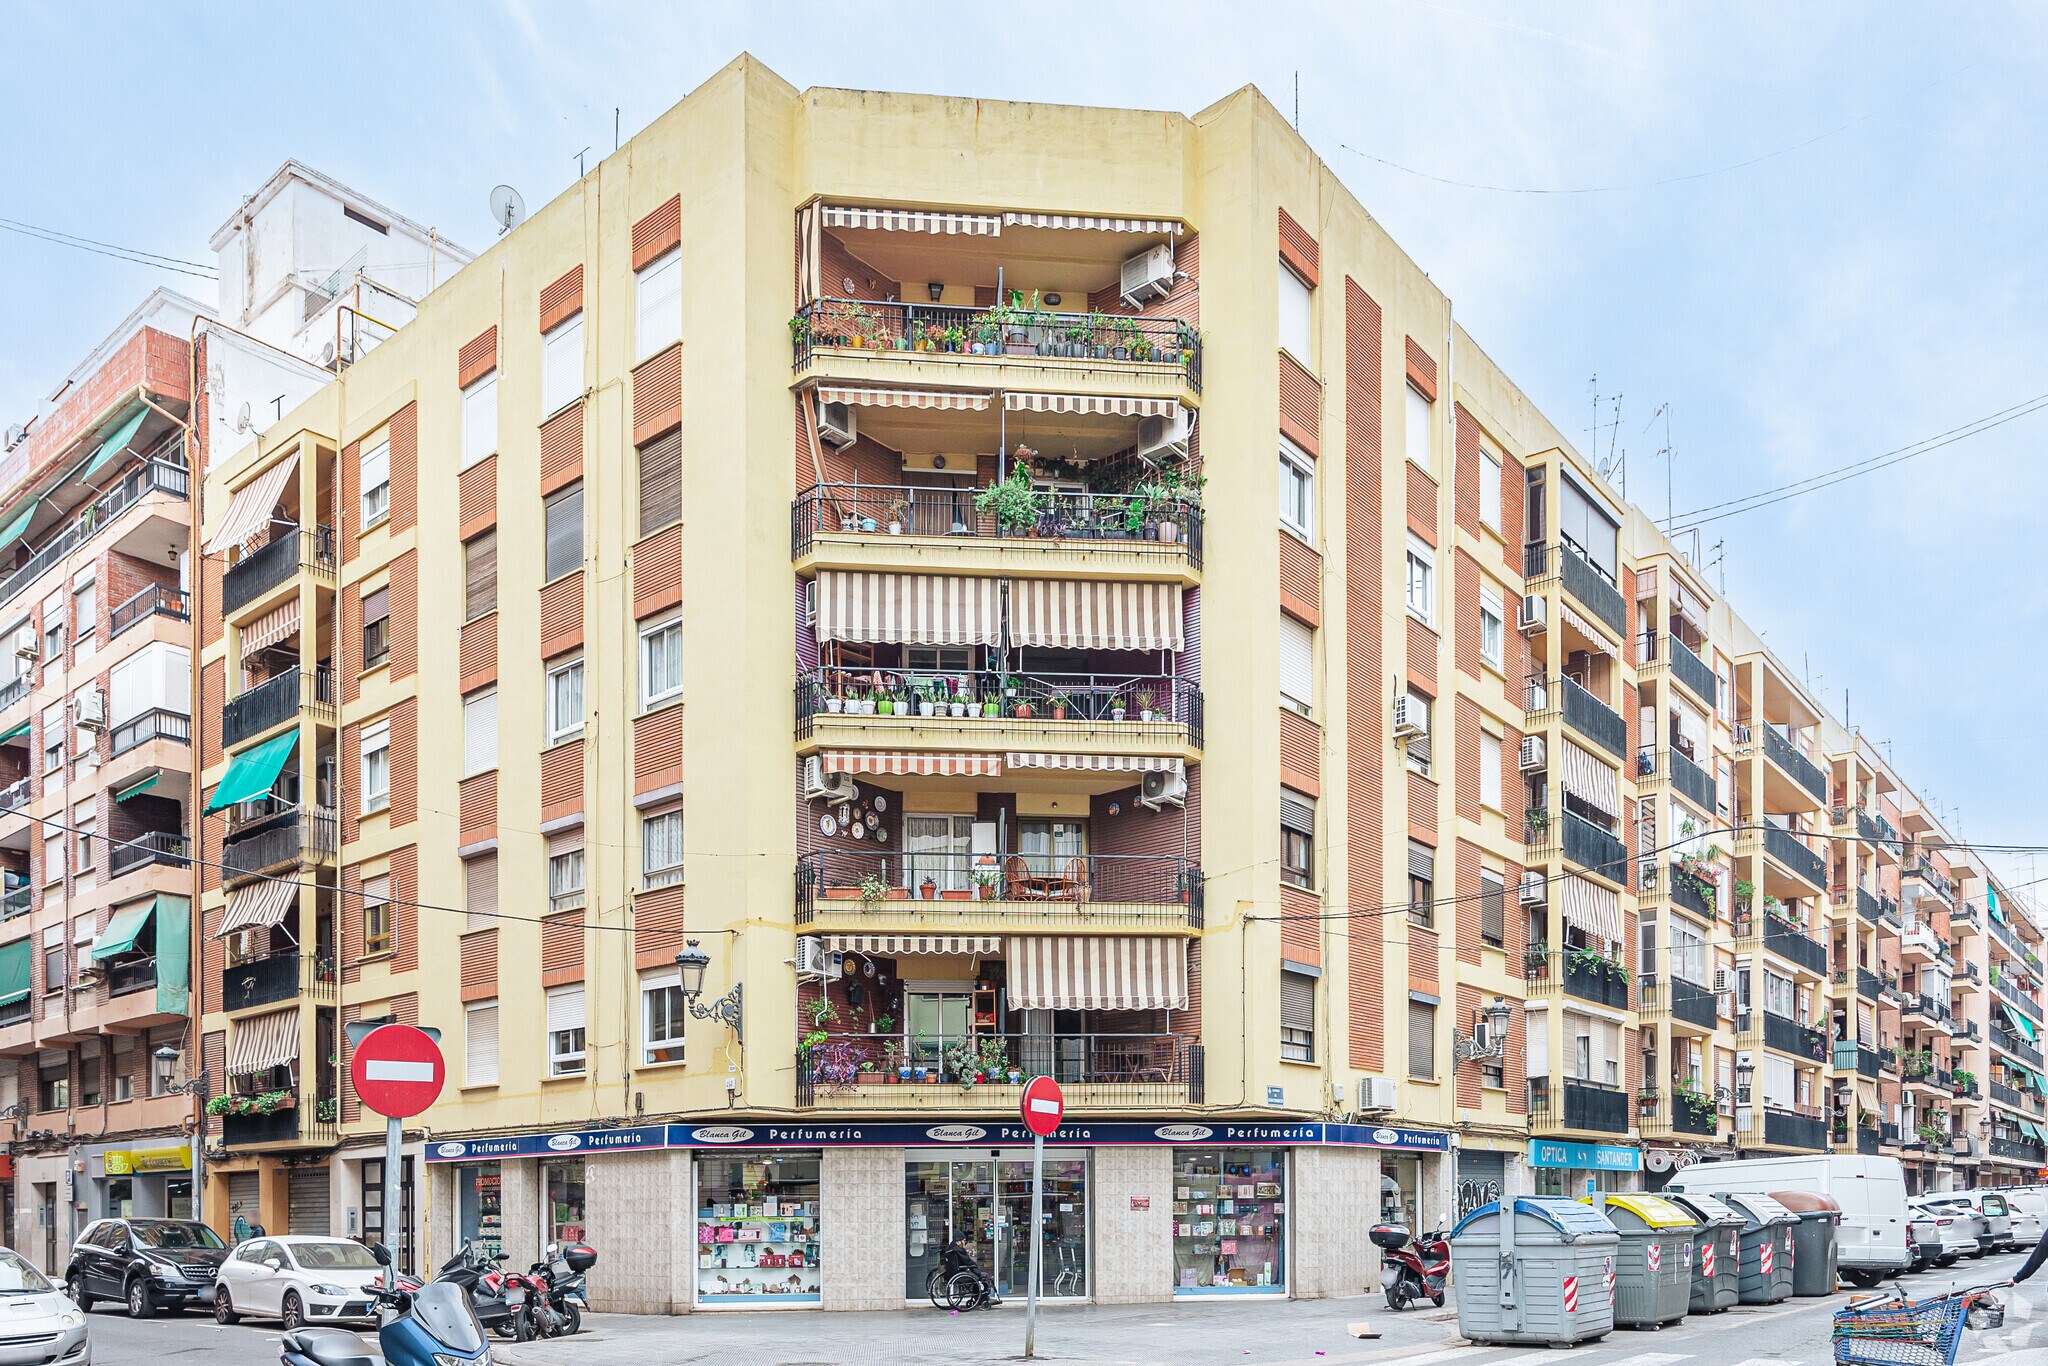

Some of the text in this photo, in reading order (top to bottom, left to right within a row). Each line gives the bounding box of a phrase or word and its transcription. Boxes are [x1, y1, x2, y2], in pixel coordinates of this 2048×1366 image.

[700, 1129, 747, 1139] Blanca Gil
[770, 1129, 862, 1139] Perfumería
[933, 1128, 980, 1138] Blanca Gil
[1001, 1127, 1091, 1138] Permería
[1161, 1127, 1206, 1137] Blanca Gil
[1227, 1127, 1314, 1138] Perfumería
[588, 1132, 641, 1146] Perfumería
[1403, 1133, 1440, 1146] Perfumería
[471, 1141, 517, 1154] Perfumería
[1597, 1151, 1633, 1167] SANTANDER
